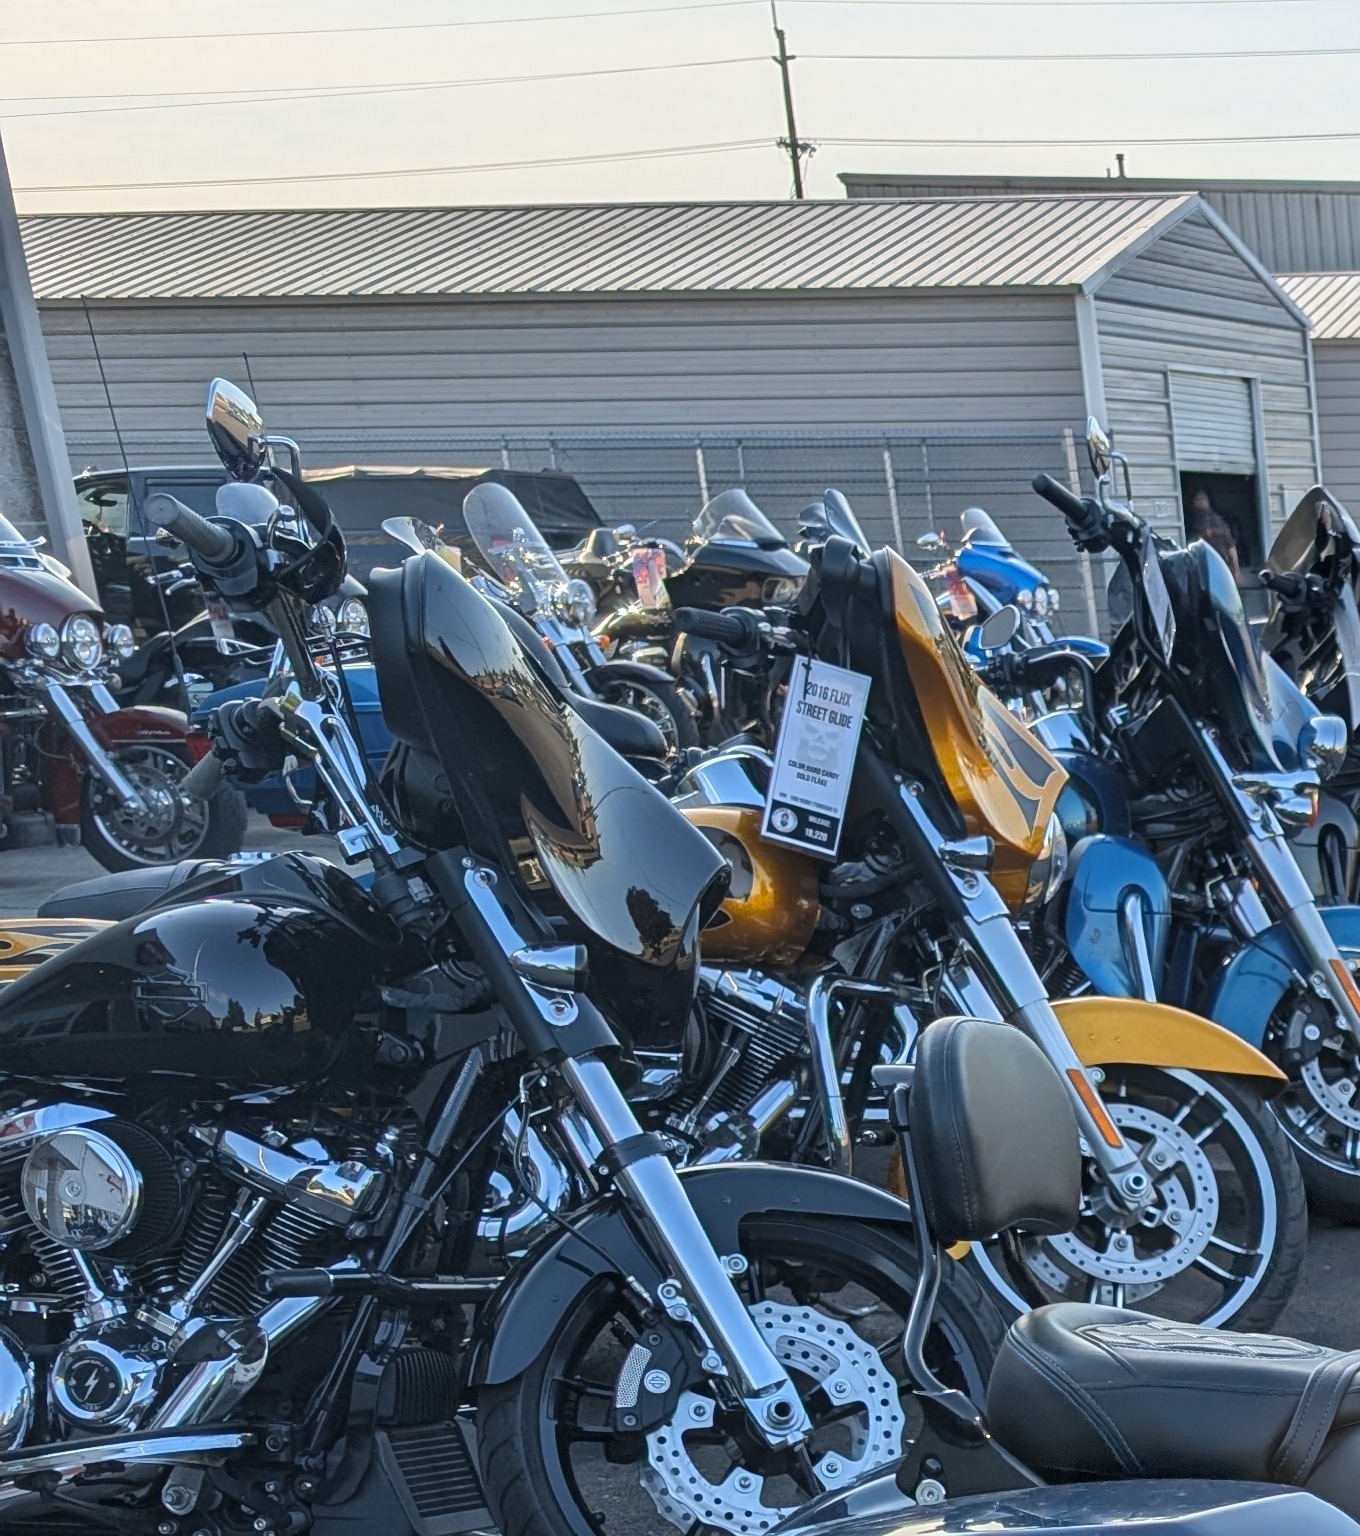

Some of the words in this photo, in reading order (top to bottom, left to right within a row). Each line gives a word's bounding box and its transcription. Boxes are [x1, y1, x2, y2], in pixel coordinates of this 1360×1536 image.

[806, 681, 829, 700] 2016
[829, 688, 853, 707] FLHX
[796, 700, 829, 721] STREET
[828, 709, 853, 729] GLIDE
[796, 771, 811, 782] GOLD
[810, 776, 828, 787] FLAKE
[821, 769, 840, 780] CANDY
